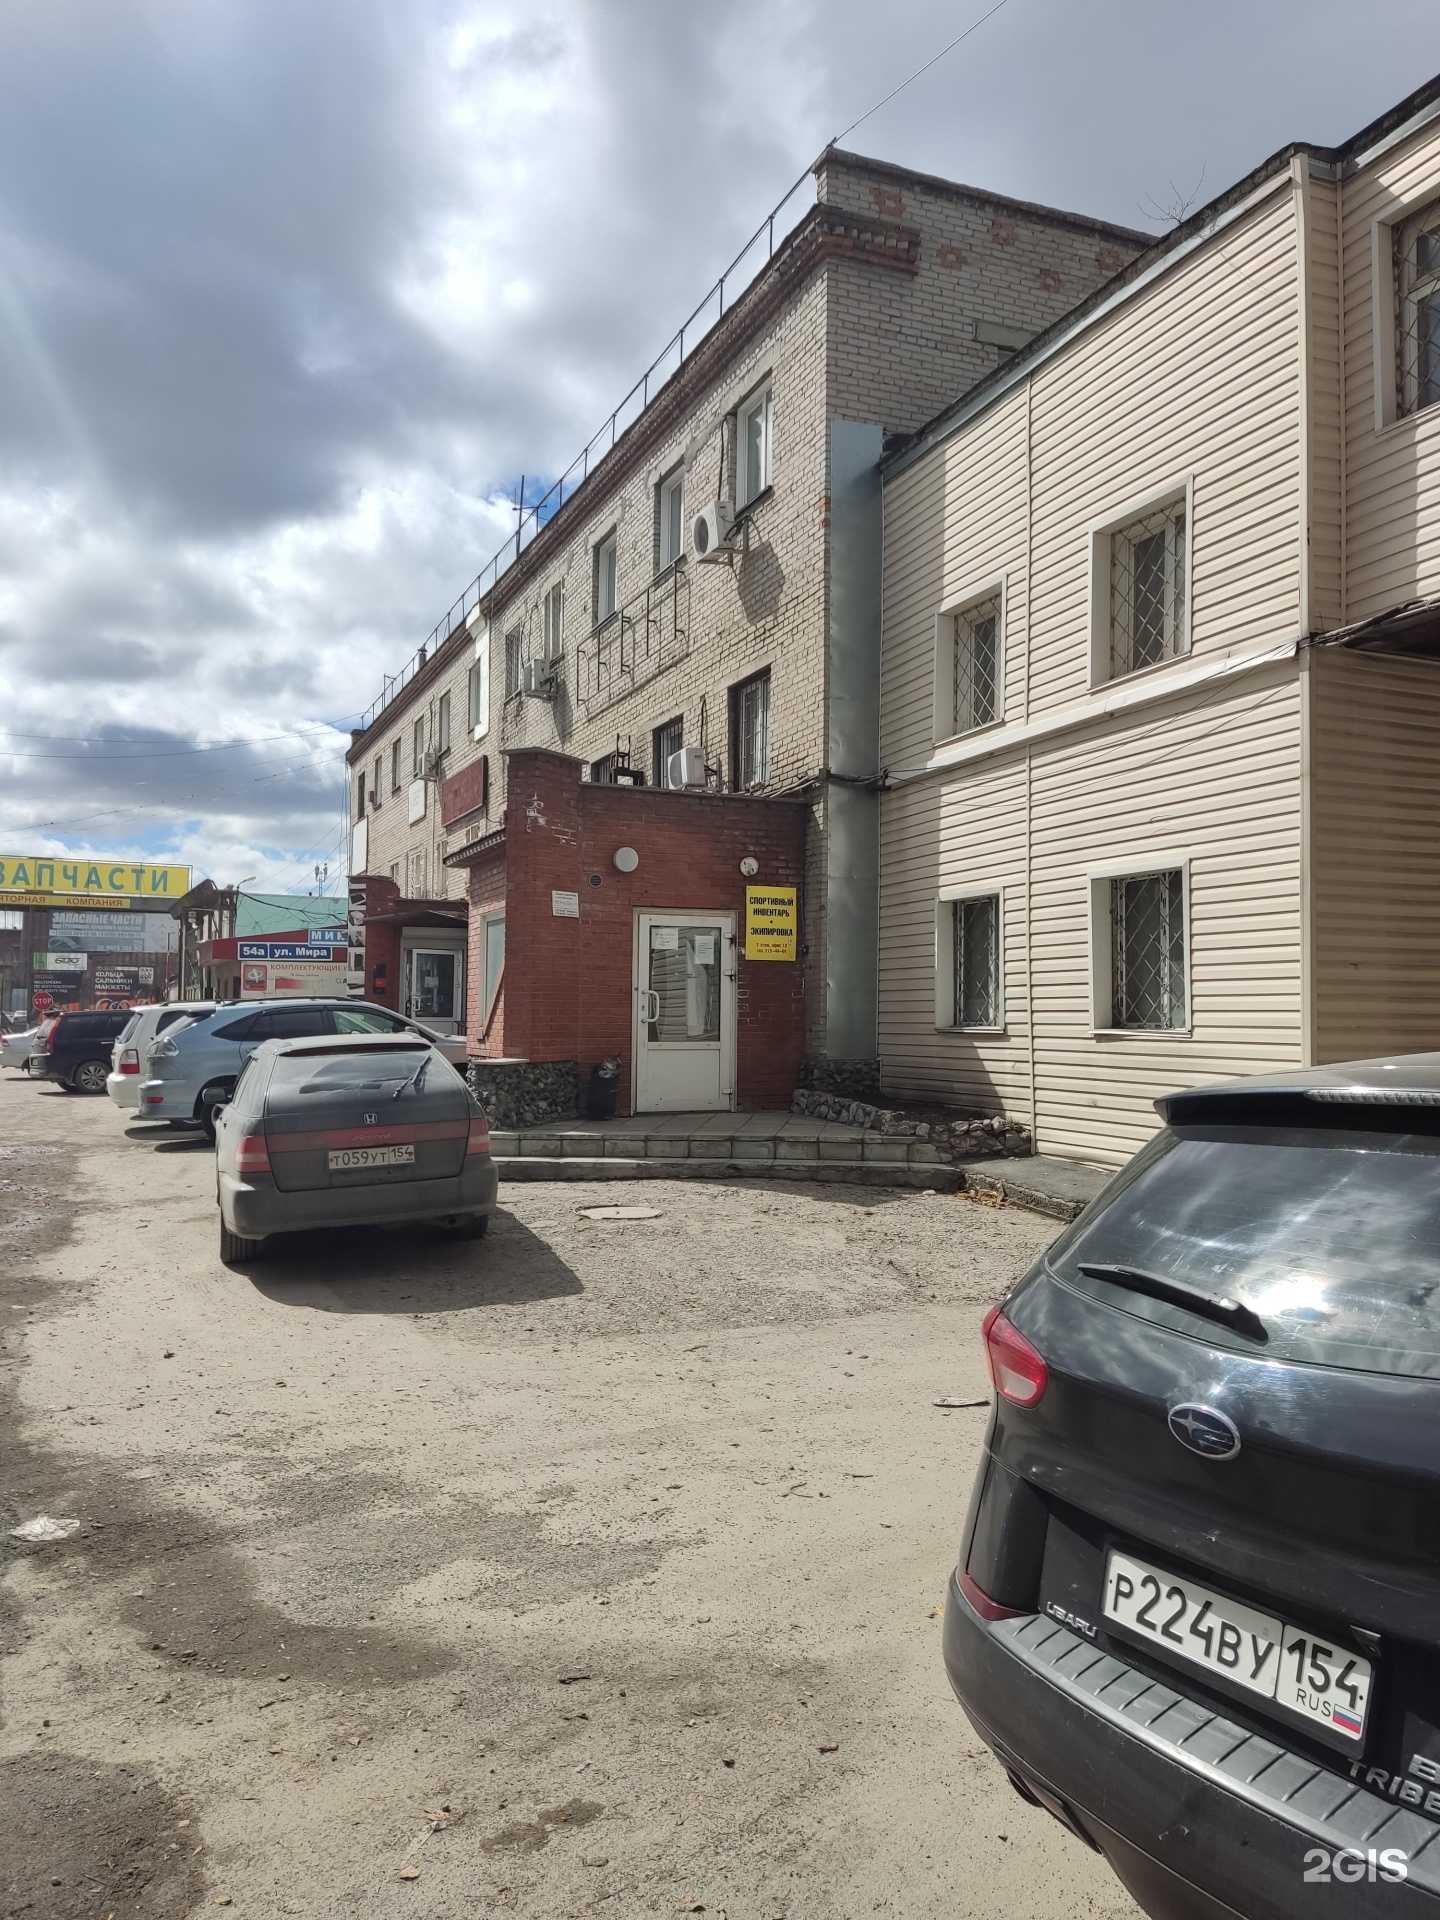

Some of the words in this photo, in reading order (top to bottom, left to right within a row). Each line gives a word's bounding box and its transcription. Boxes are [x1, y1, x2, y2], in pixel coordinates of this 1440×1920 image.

[66, 899, 123, 907] КОМПАНИЯ
[749, 896, 794, 907] СПОРТИВНЫЙ
[753, 908, 790, 918] ИНВЕНТАРЬ
[750, 927, 793, 937] ЭКИПИРОВКА
[274, 948, 292, 958] ул.
[295, 947, 328, 958] Мира
[1111, 1571, 1275, 1680] Р224ВУ
[1285, 1636, 1360, 1709] 154
[1295, 1687, 1332, 1718] RUS
